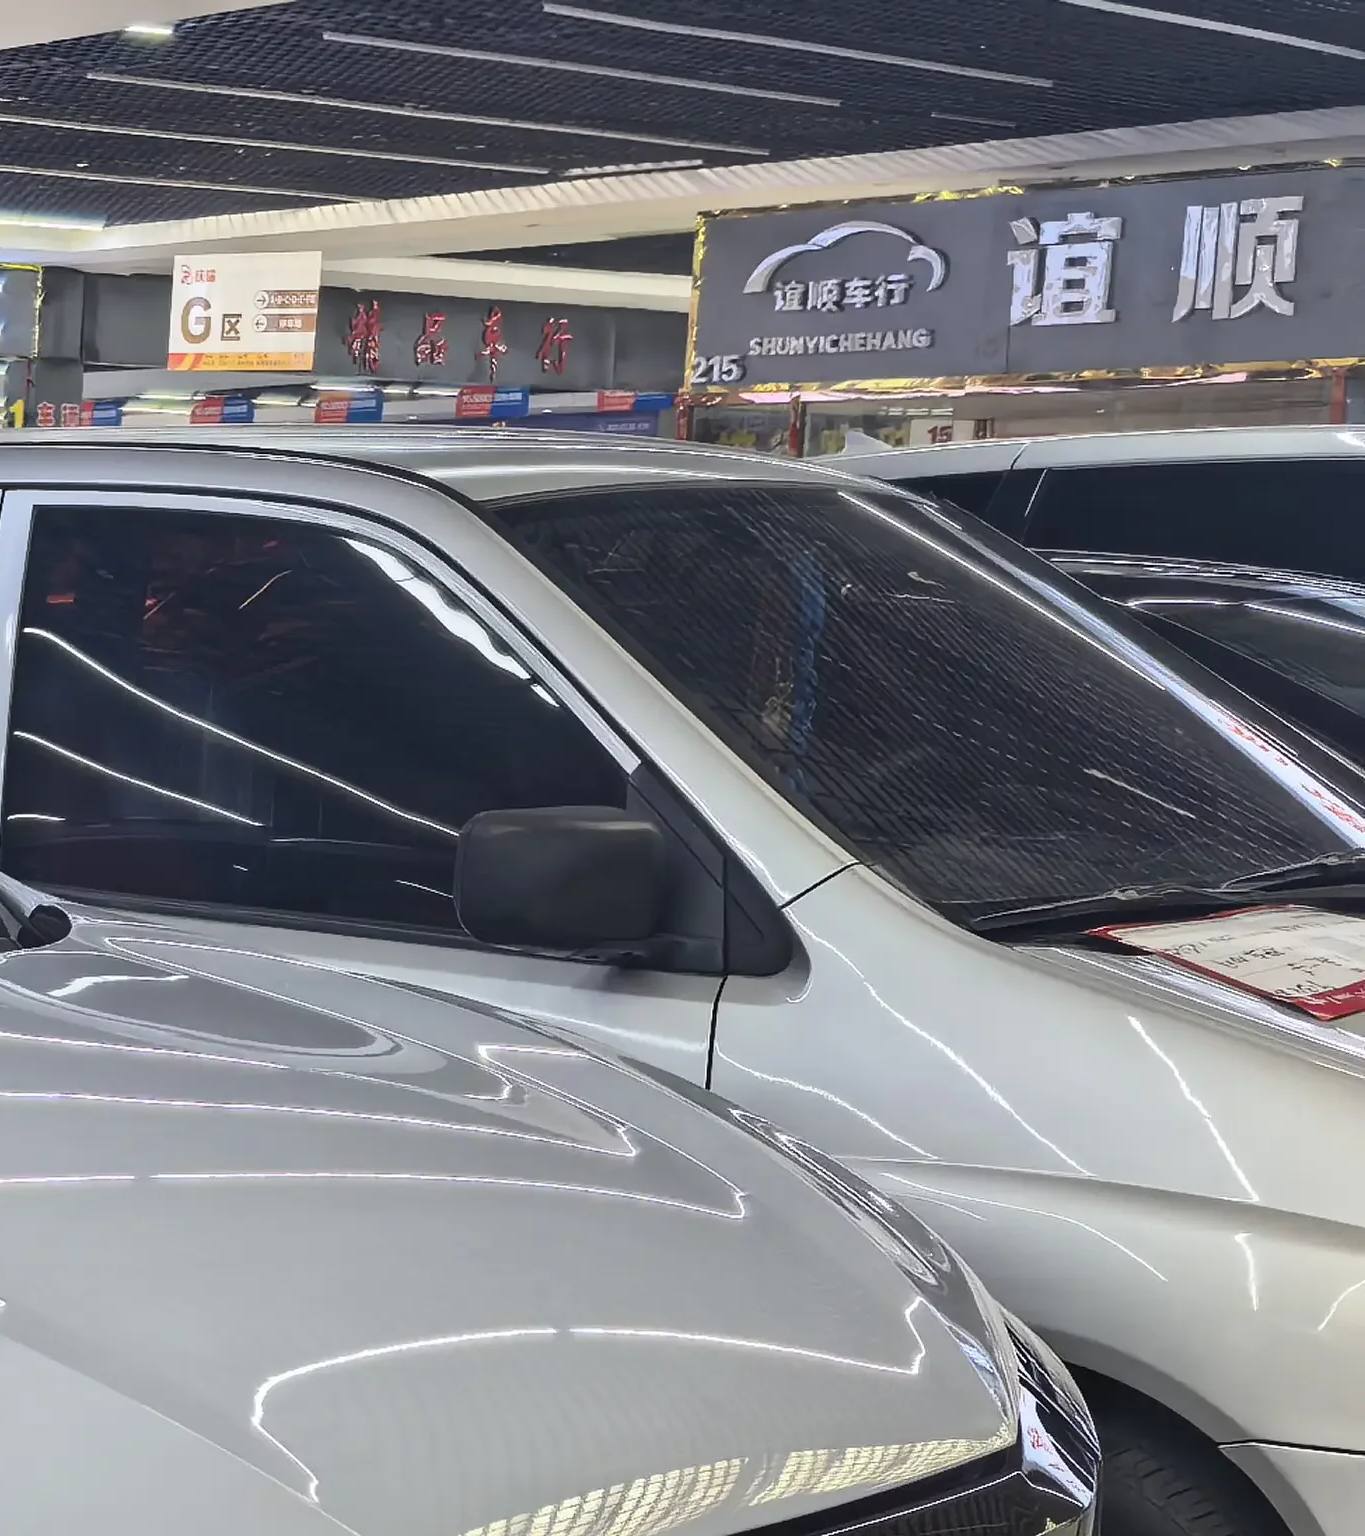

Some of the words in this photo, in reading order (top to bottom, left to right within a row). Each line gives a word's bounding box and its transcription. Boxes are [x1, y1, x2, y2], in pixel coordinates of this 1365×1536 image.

[1007, 196, 1304, 326] 谊顺
[774, 273, 911, 312] 谊顺车行
[748, 328, 933, 356] SHUNYICHEHANG
[691, 355, 743, 384] 215
